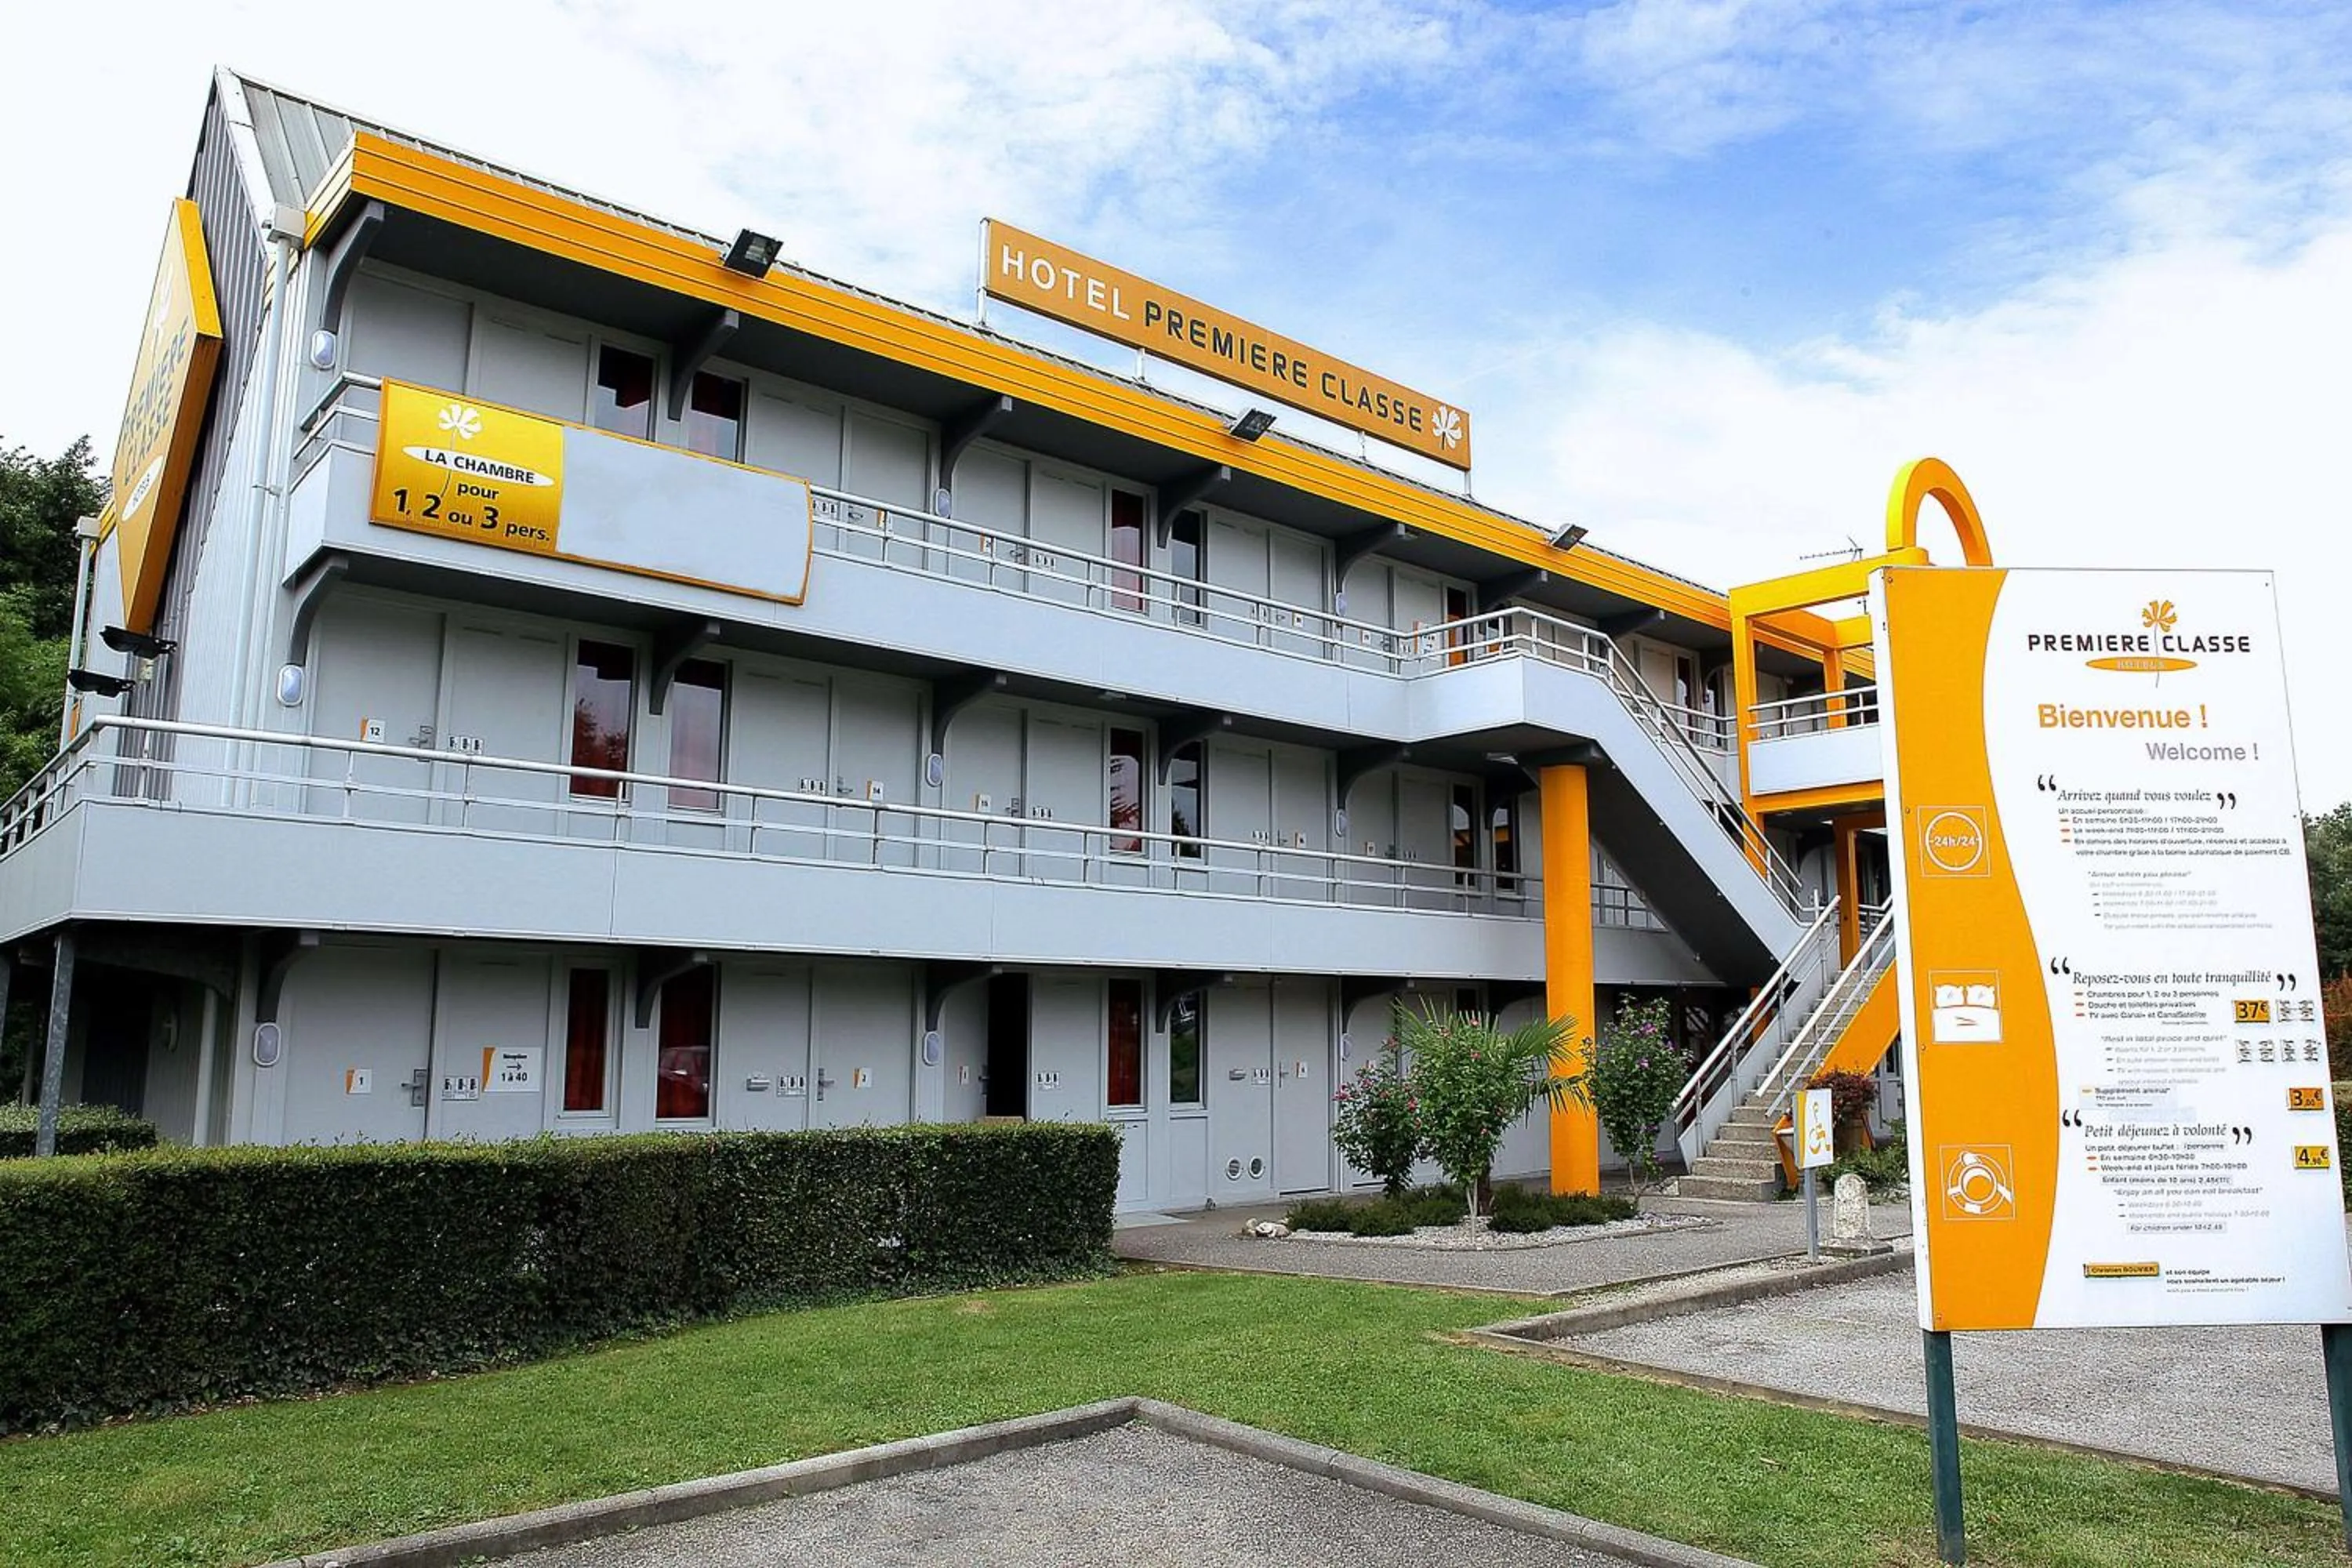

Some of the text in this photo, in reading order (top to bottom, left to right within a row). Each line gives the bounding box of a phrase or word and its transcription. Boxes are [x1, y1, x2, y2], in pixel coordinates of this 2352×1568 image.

[1003, 244, 1423, 433] HOTEL PREMIERE CLASSE
[424, 448, 535, 484] LA CHAMBRE
[458, 482, 499, 501] pour
[394, 488, 550, 542] 1, 2 ou 3 pers.
[2027, 634, 2251, 653] PREMIERE CLASSE
[2038, 704, 2190, 728] Bienvenue
[370, 727, 380, 735] 12
[2146, 743, 2245, 760] Welcome
[2057, 788, 2212, 804] Arrivez quand vous voulez
[2072, 970, 2271, 987] Reposez-vous en toute tranquillité
[515, 1073, 528, 1081] 40
[2085, 1123, 2227, 1141] Petit déjeunez à volonté
